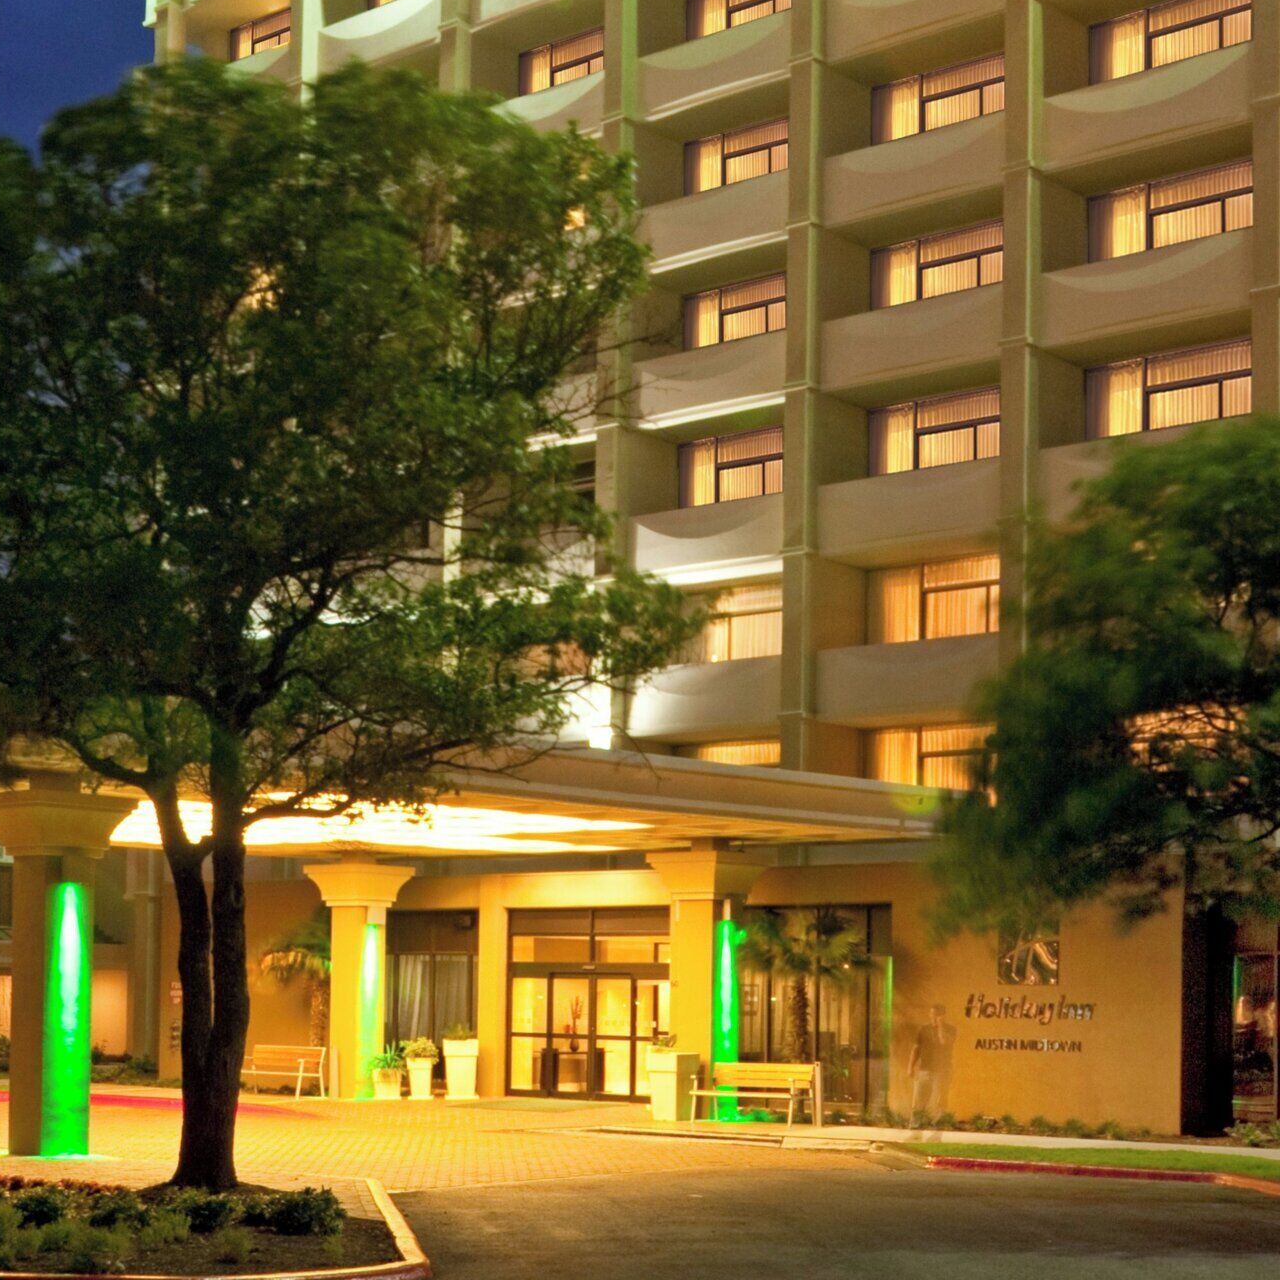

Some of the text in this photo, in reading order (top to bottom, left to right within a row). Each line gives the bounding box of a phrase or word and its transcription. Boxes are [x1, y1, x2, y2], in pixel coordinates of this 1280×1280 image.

[965, 993, 1095, 1025] Holiday Inn
[975, 1038, 1082, 1052] AUSTIN MIDTOWN
